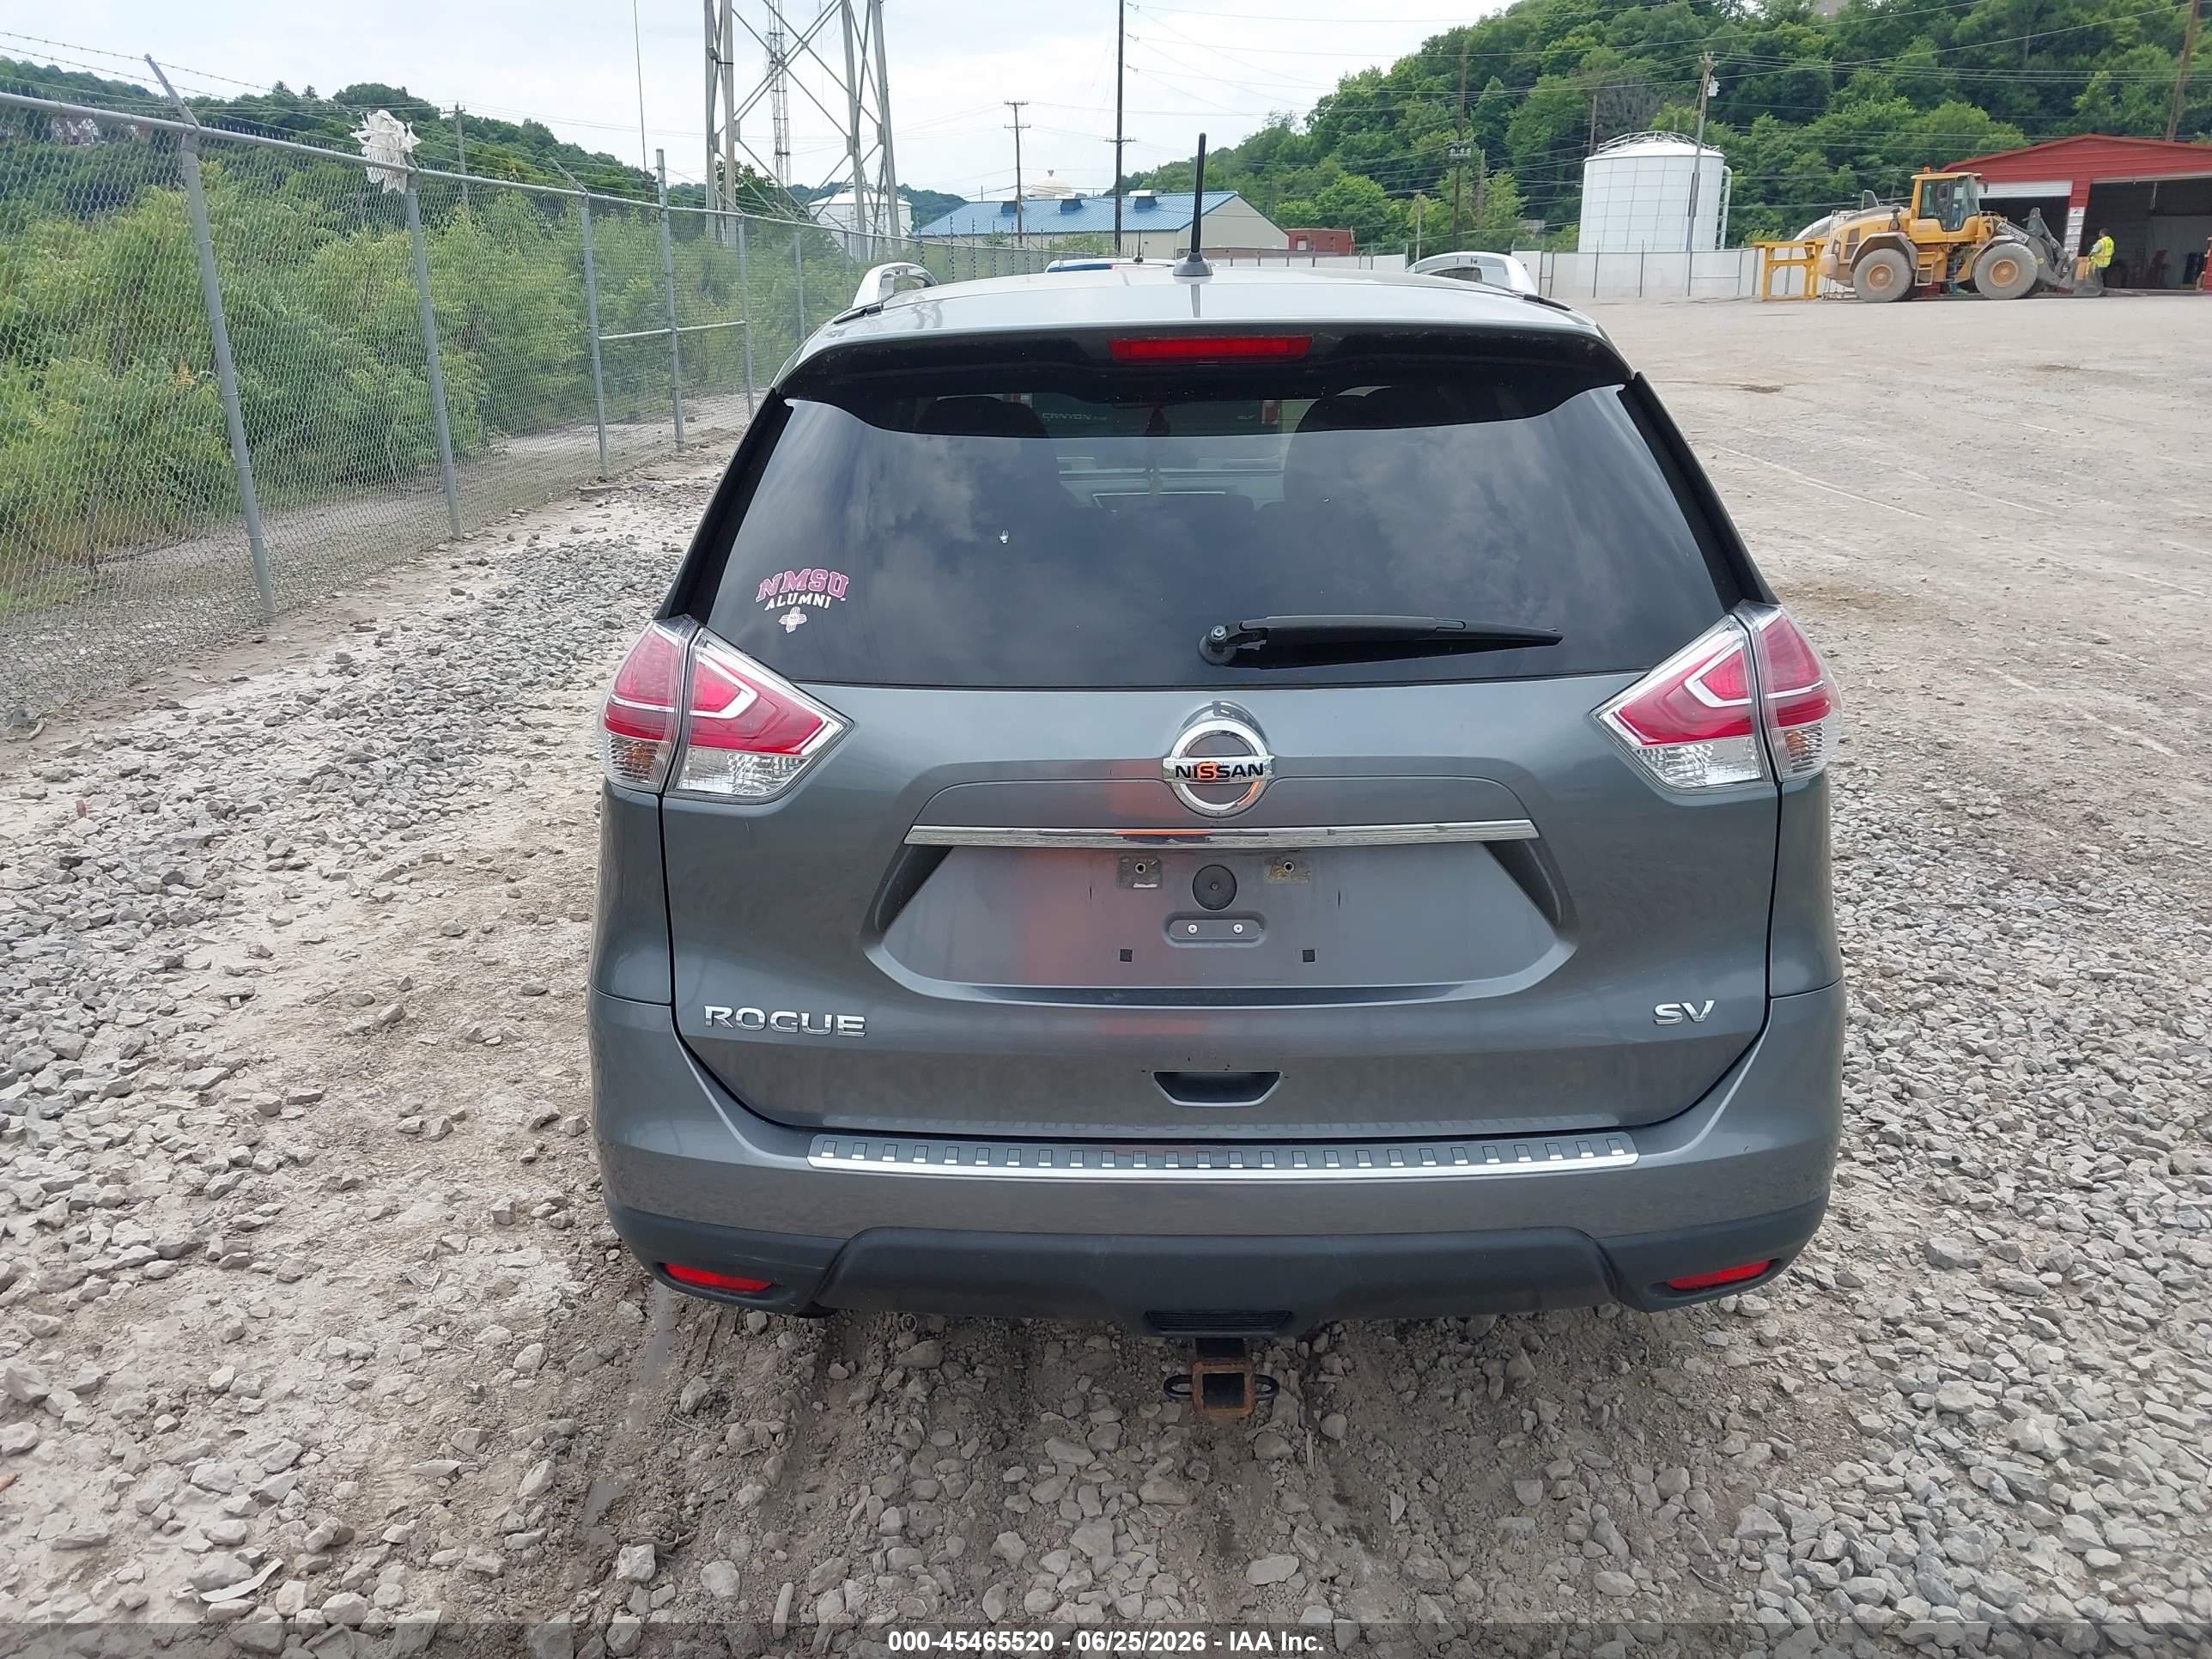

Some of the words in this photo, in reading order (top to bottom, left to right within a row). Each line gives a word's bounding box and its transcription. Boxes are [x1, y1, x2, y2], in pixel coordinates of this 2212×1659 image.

[755, 568, 849, 603] NMSU
[763, 592, 832, 611] ALUMNI
[1175, 763, 1264, 779] NISSAN
[703, 1005, 866, 1038] ROGUE
[1654, 1000, 1716, 1026] SV
